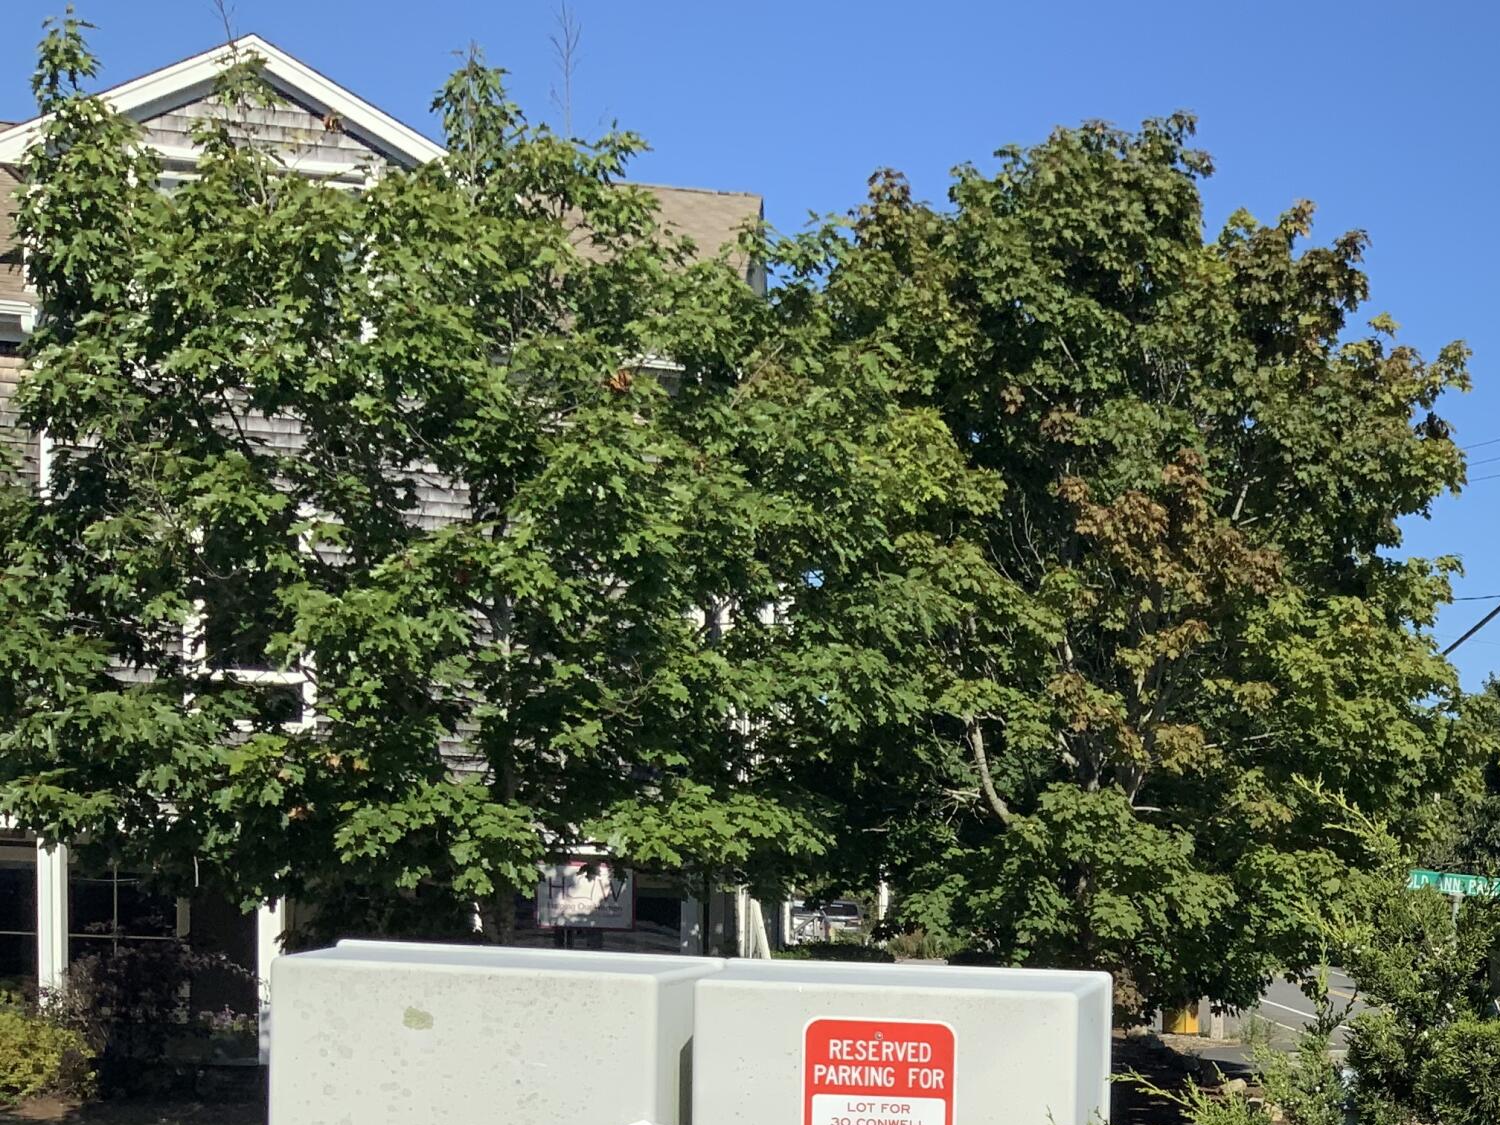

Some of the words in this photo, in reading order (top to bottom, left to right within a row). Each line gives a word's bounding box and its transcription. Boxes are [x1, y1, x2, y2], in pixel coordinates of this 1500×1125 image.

[829, 1039, 932, 1063] RESERVED
[814, 1064, 895, 1088] PARKING
[908, 1068, 944, 1089] FOR
[847, 1102, 876, 1113] LOT
[881, 1103, 911, 1114] FOR
